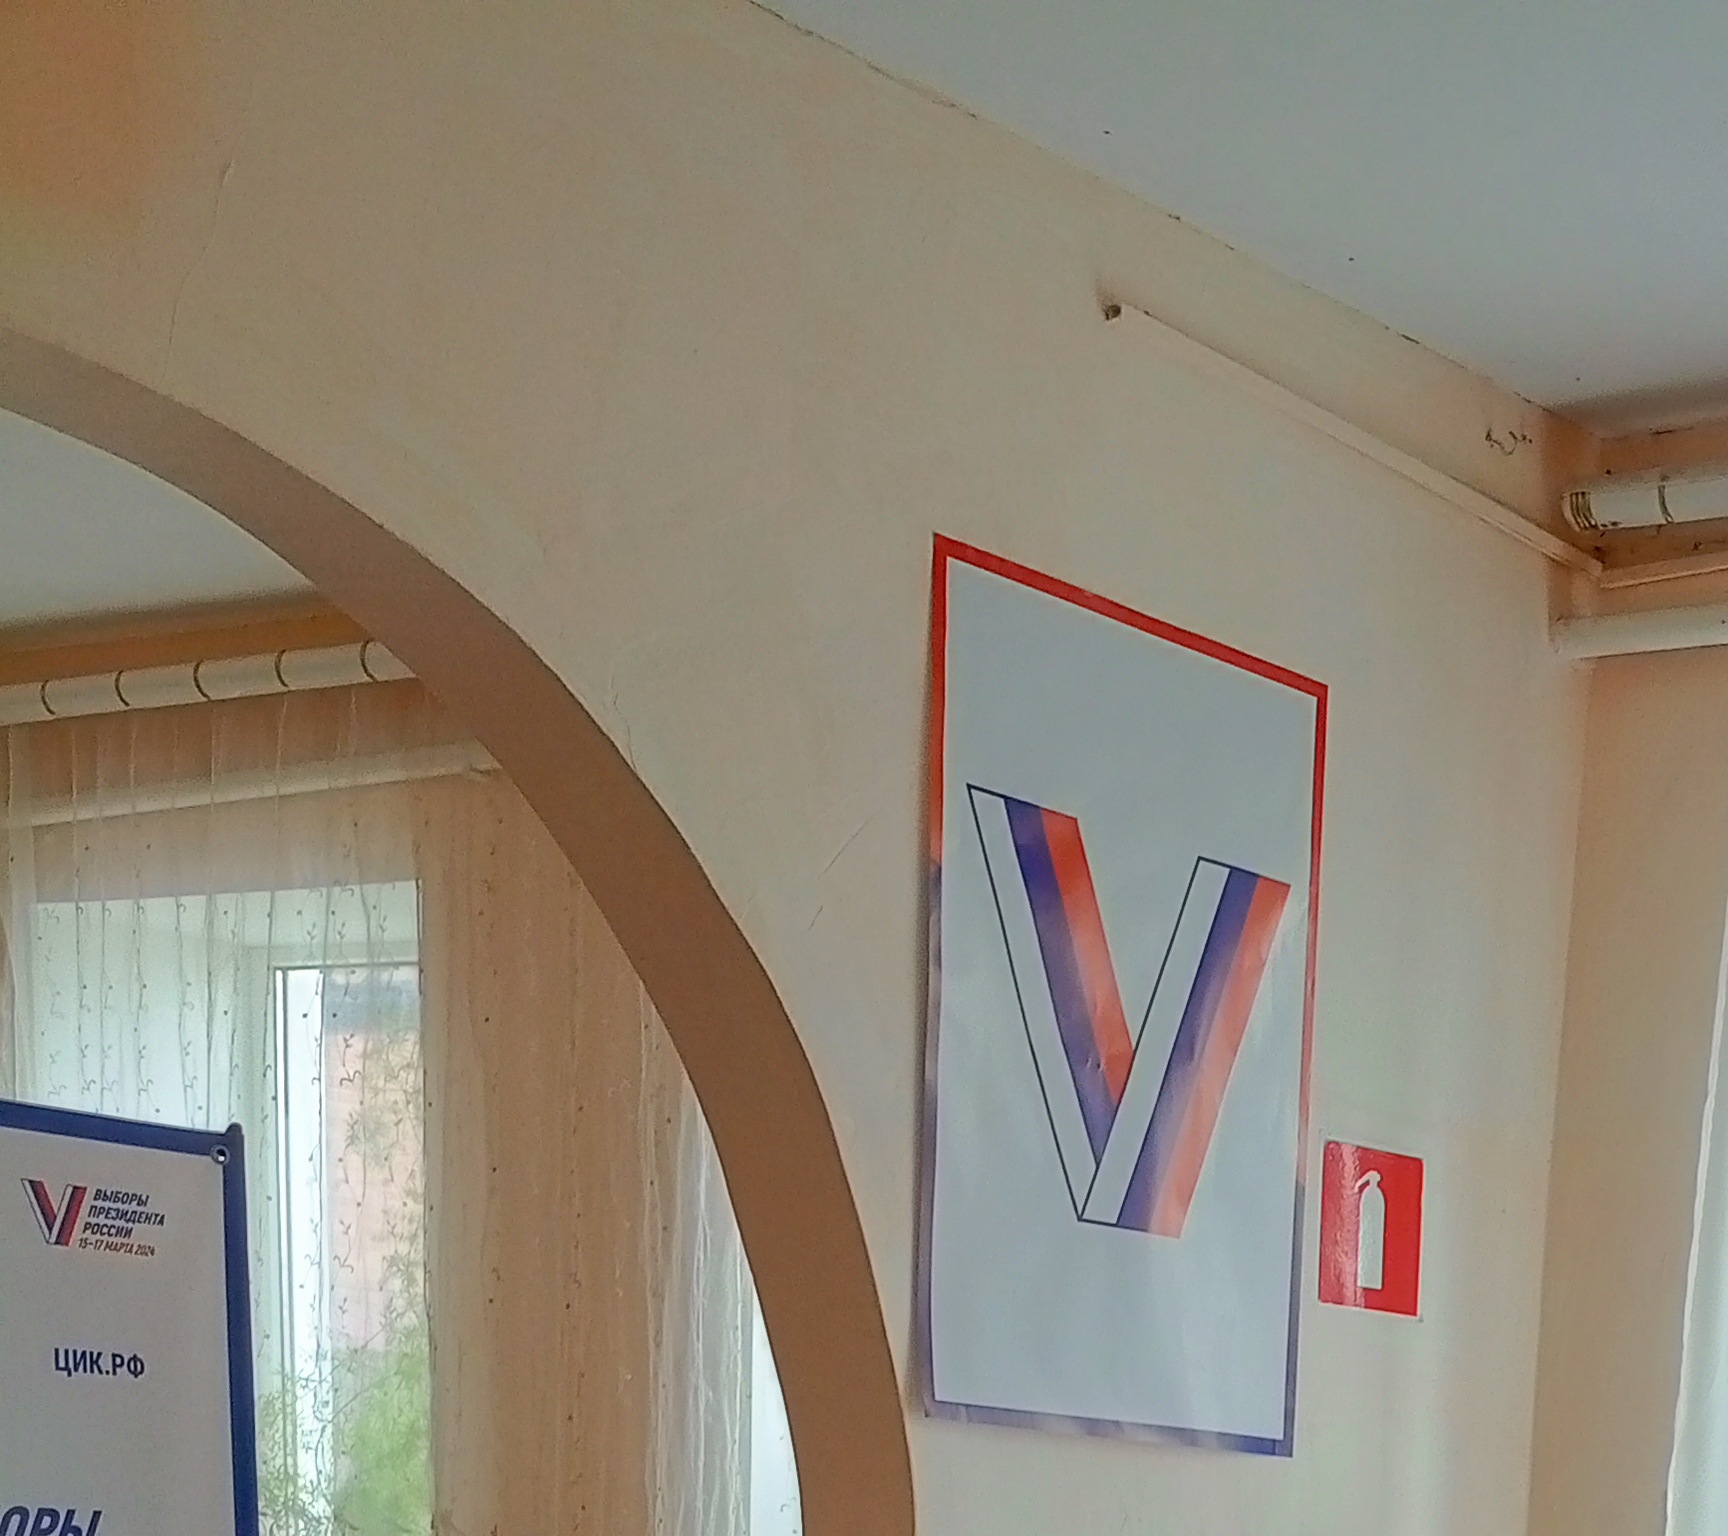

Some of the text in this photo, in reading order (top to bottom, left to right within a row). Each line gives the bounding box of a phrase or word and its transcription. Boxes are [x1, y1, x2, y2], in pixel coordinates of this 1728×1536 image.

[93, 1188, 149, 1207] ВЫБОРЫ
[87, 1204, 165, 1227] ПРЕЗИДЕНТА
[82, 1221, 134, 1239] РОССИИ
[104, 1240, 135, 1255] МАРТА
[134, 1243, 156, 1257] 2024
[53, 1347, 146, 1379] ЦИК.РФ
